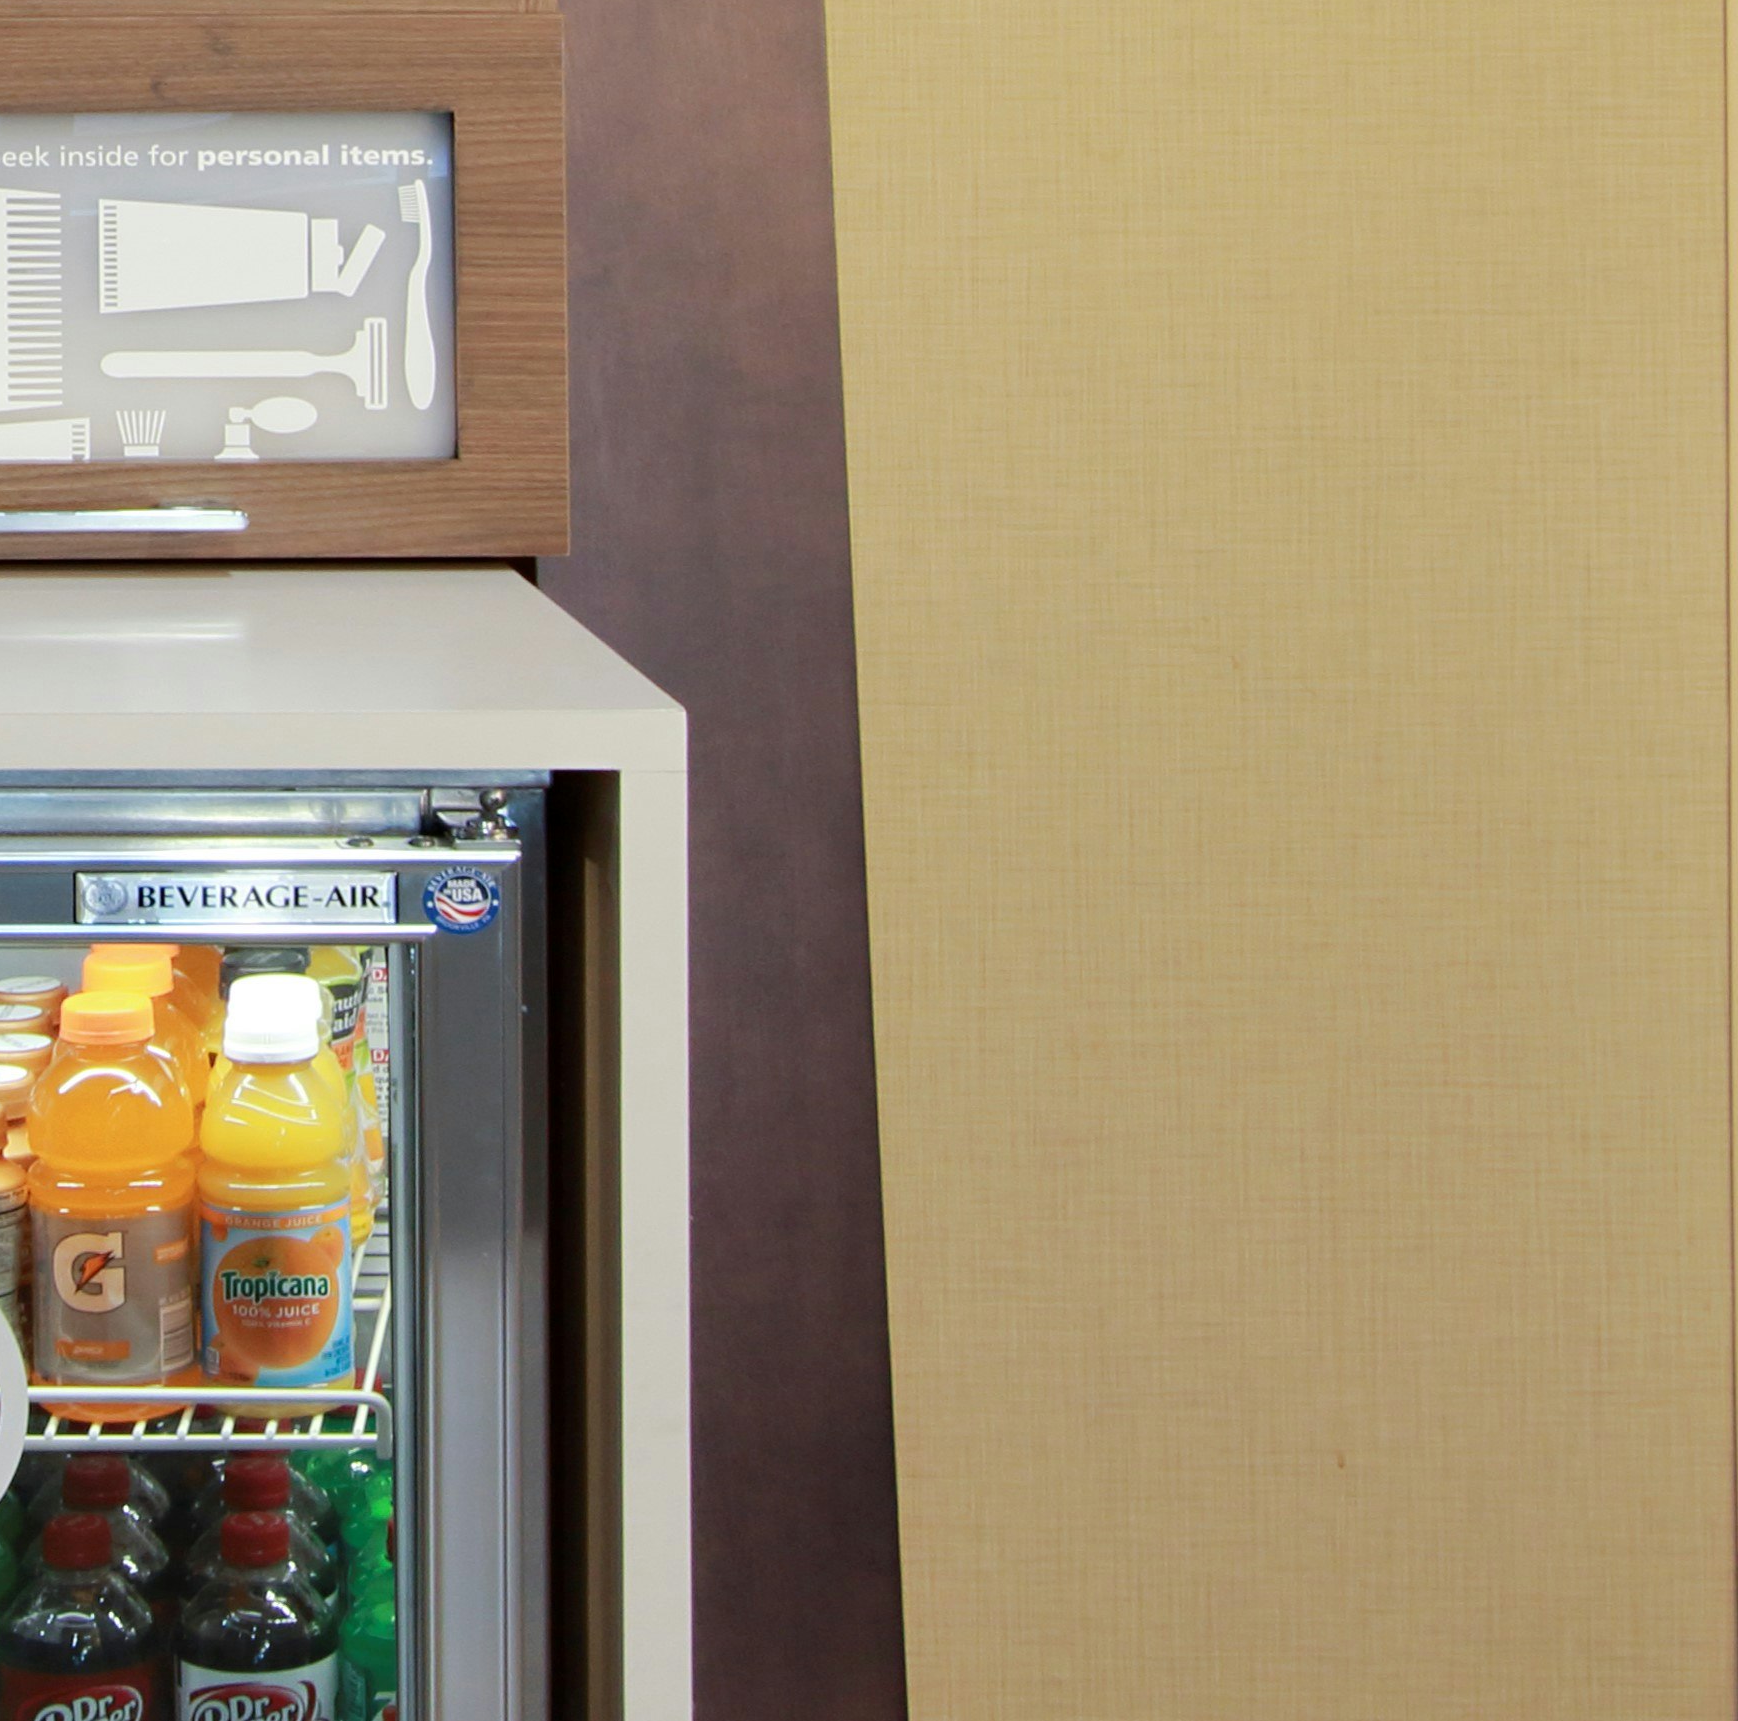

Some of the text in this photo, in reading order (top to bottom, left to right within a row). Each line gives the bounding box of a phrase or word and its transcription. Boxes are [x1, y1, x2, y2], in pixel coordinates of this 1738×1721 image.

[59, 145, 139, 168] inside
[147, 144, 189, 167] for
[196, 144, 330, 171] personal
[340, 144, 434, 167] items.
[136, 884, 382, 910] BEVERAGE-AIR
[451, 887, 484, 902] USA
[285, 1214, 323, 1227] JUICE
[53, 1231, 127, 1314] G
[221, 1270, 330, 1304] Tropicana
[232, 1303, 320, 1318] 100% JUICE
